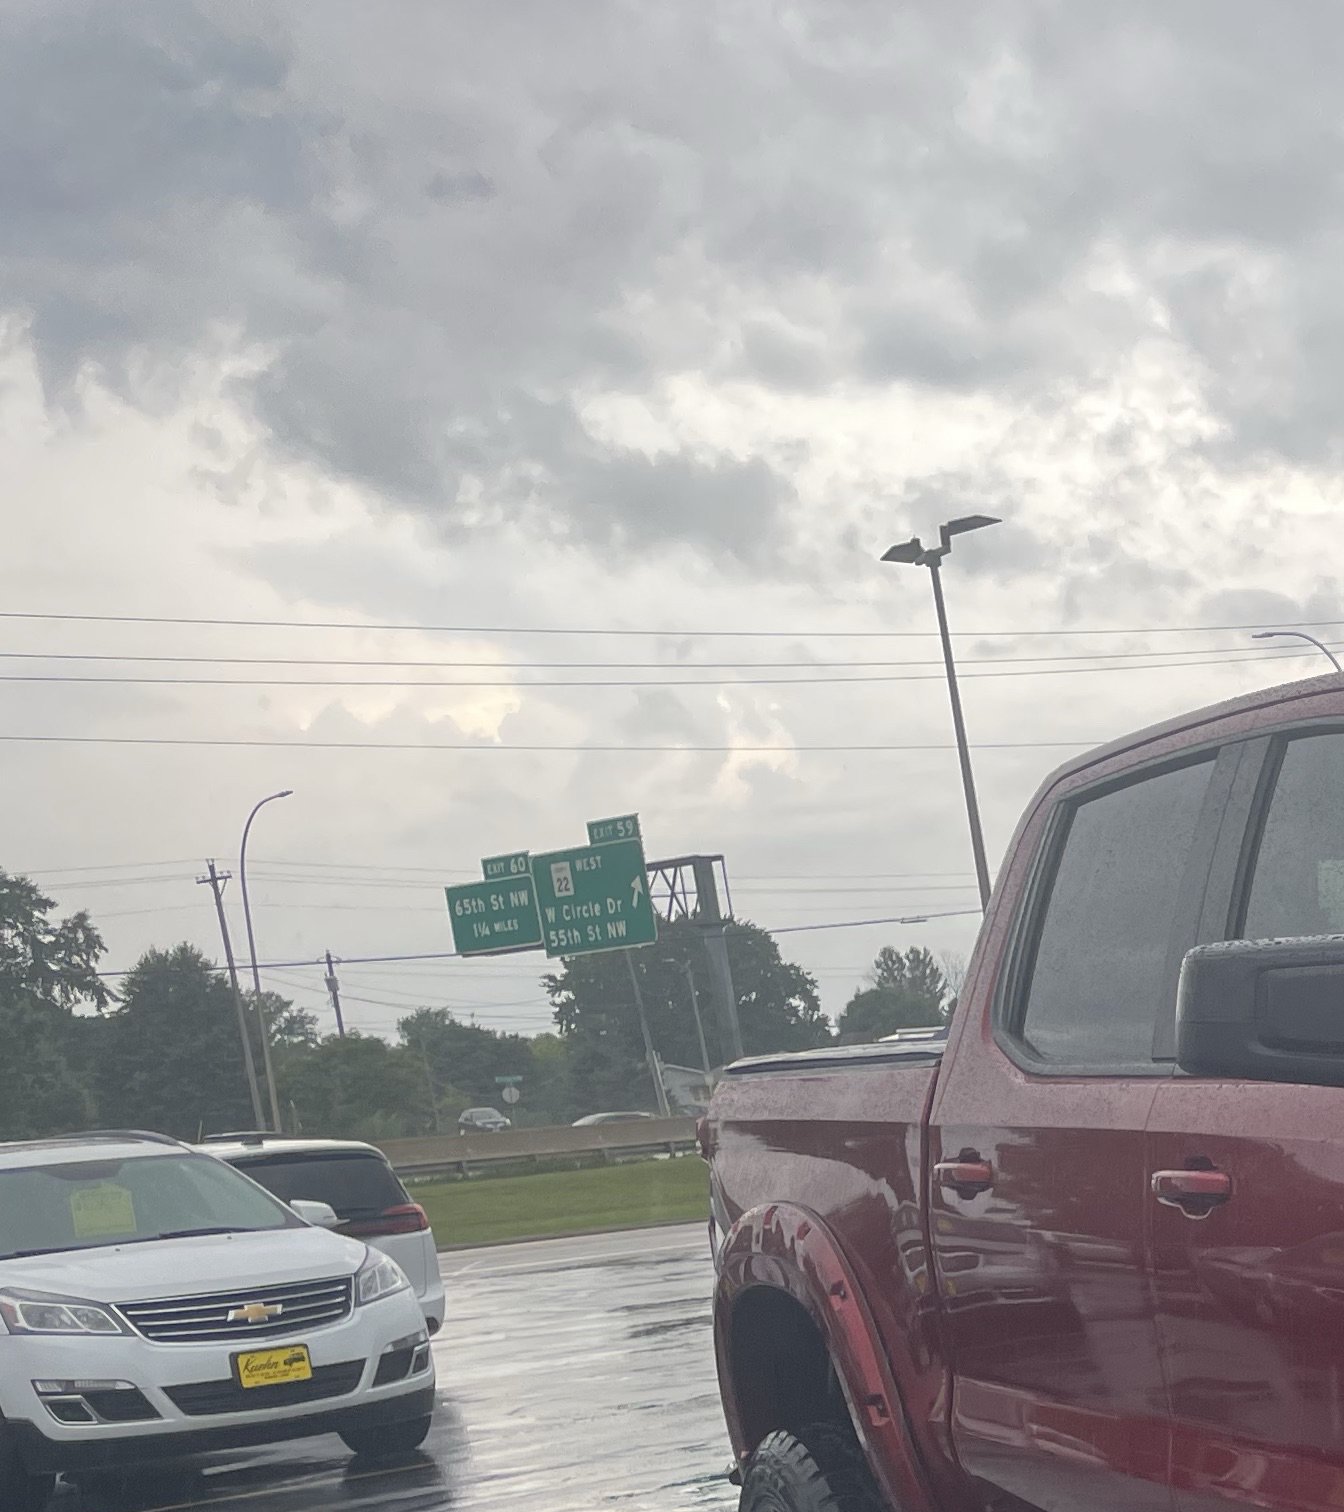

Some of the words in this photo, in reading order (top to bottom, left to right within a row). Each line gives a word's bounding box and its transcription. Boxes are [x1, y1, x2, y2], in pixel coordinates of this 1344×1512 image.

[593, 824, 613, 840] EXIT
[616, 820, 634, 837] 59
[487, 861, 505, 875] EXIT
[510, 857, 526, 873] 60
[575, 855, 602, 872] WEST
[556, 877, 571, 892] 22
[455, 896, 486, 917] 65th
[491, 894, 505, 911] St
[510, 890, 529, 906] NW
[545, 909, 557, 924] W
[562, 903, 601, 919] Circle
[606, 898, 623, 915] Dr
[494, 919, 519, 932] MILES
[549, 929, 582, 948] 55th
[586, 925, 602, 942] St
[607, 920, 627, 938] NW
